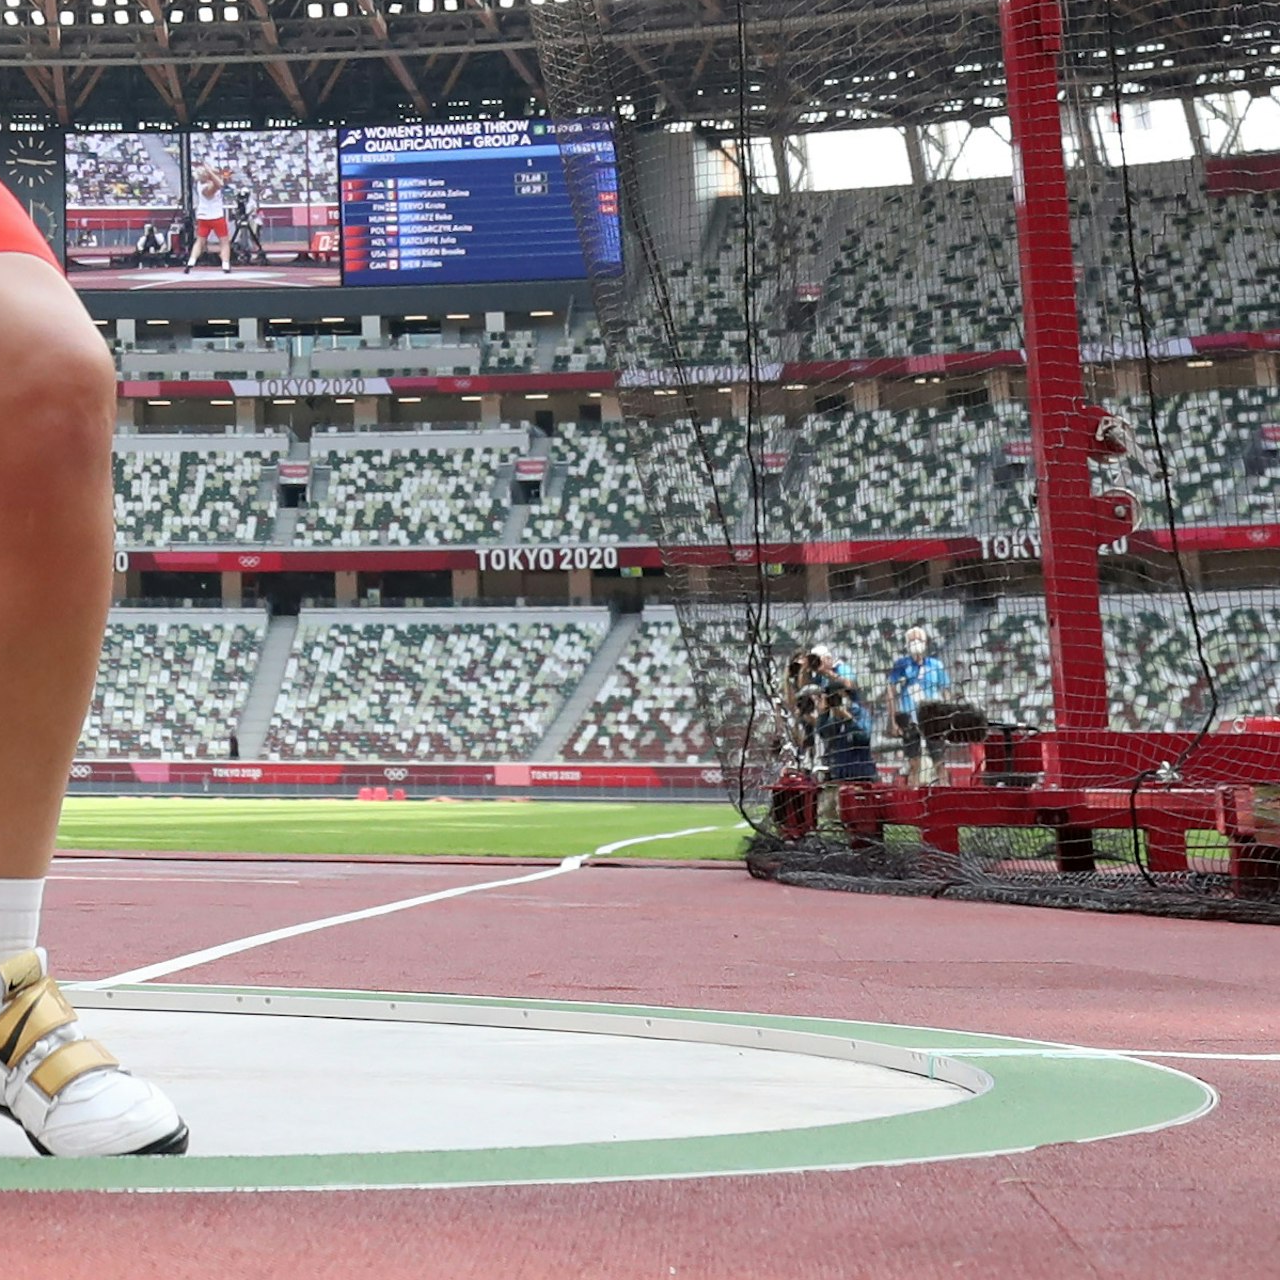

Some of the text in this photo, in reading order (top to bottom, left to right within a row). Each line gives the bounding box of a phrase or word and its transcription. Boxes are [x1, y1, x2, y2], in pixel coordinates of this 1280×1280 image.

[364, 124, 423, 139] WOMEN'S
[425, 122, 481, 137] HAMMER
[483, 120, 530, 134] THROW
[365, 137, 463, 152] QUALIFICATION
[473, 134, 519, 148] GROUP
[520, 134, 532, 146] A
[370, 250, 387, 258] USA
[369, 261, 387, 270] CAN
[257, 377, 366, 397] TOKYO 2020
[475, 547, 618, 571] TOKYO 2020
